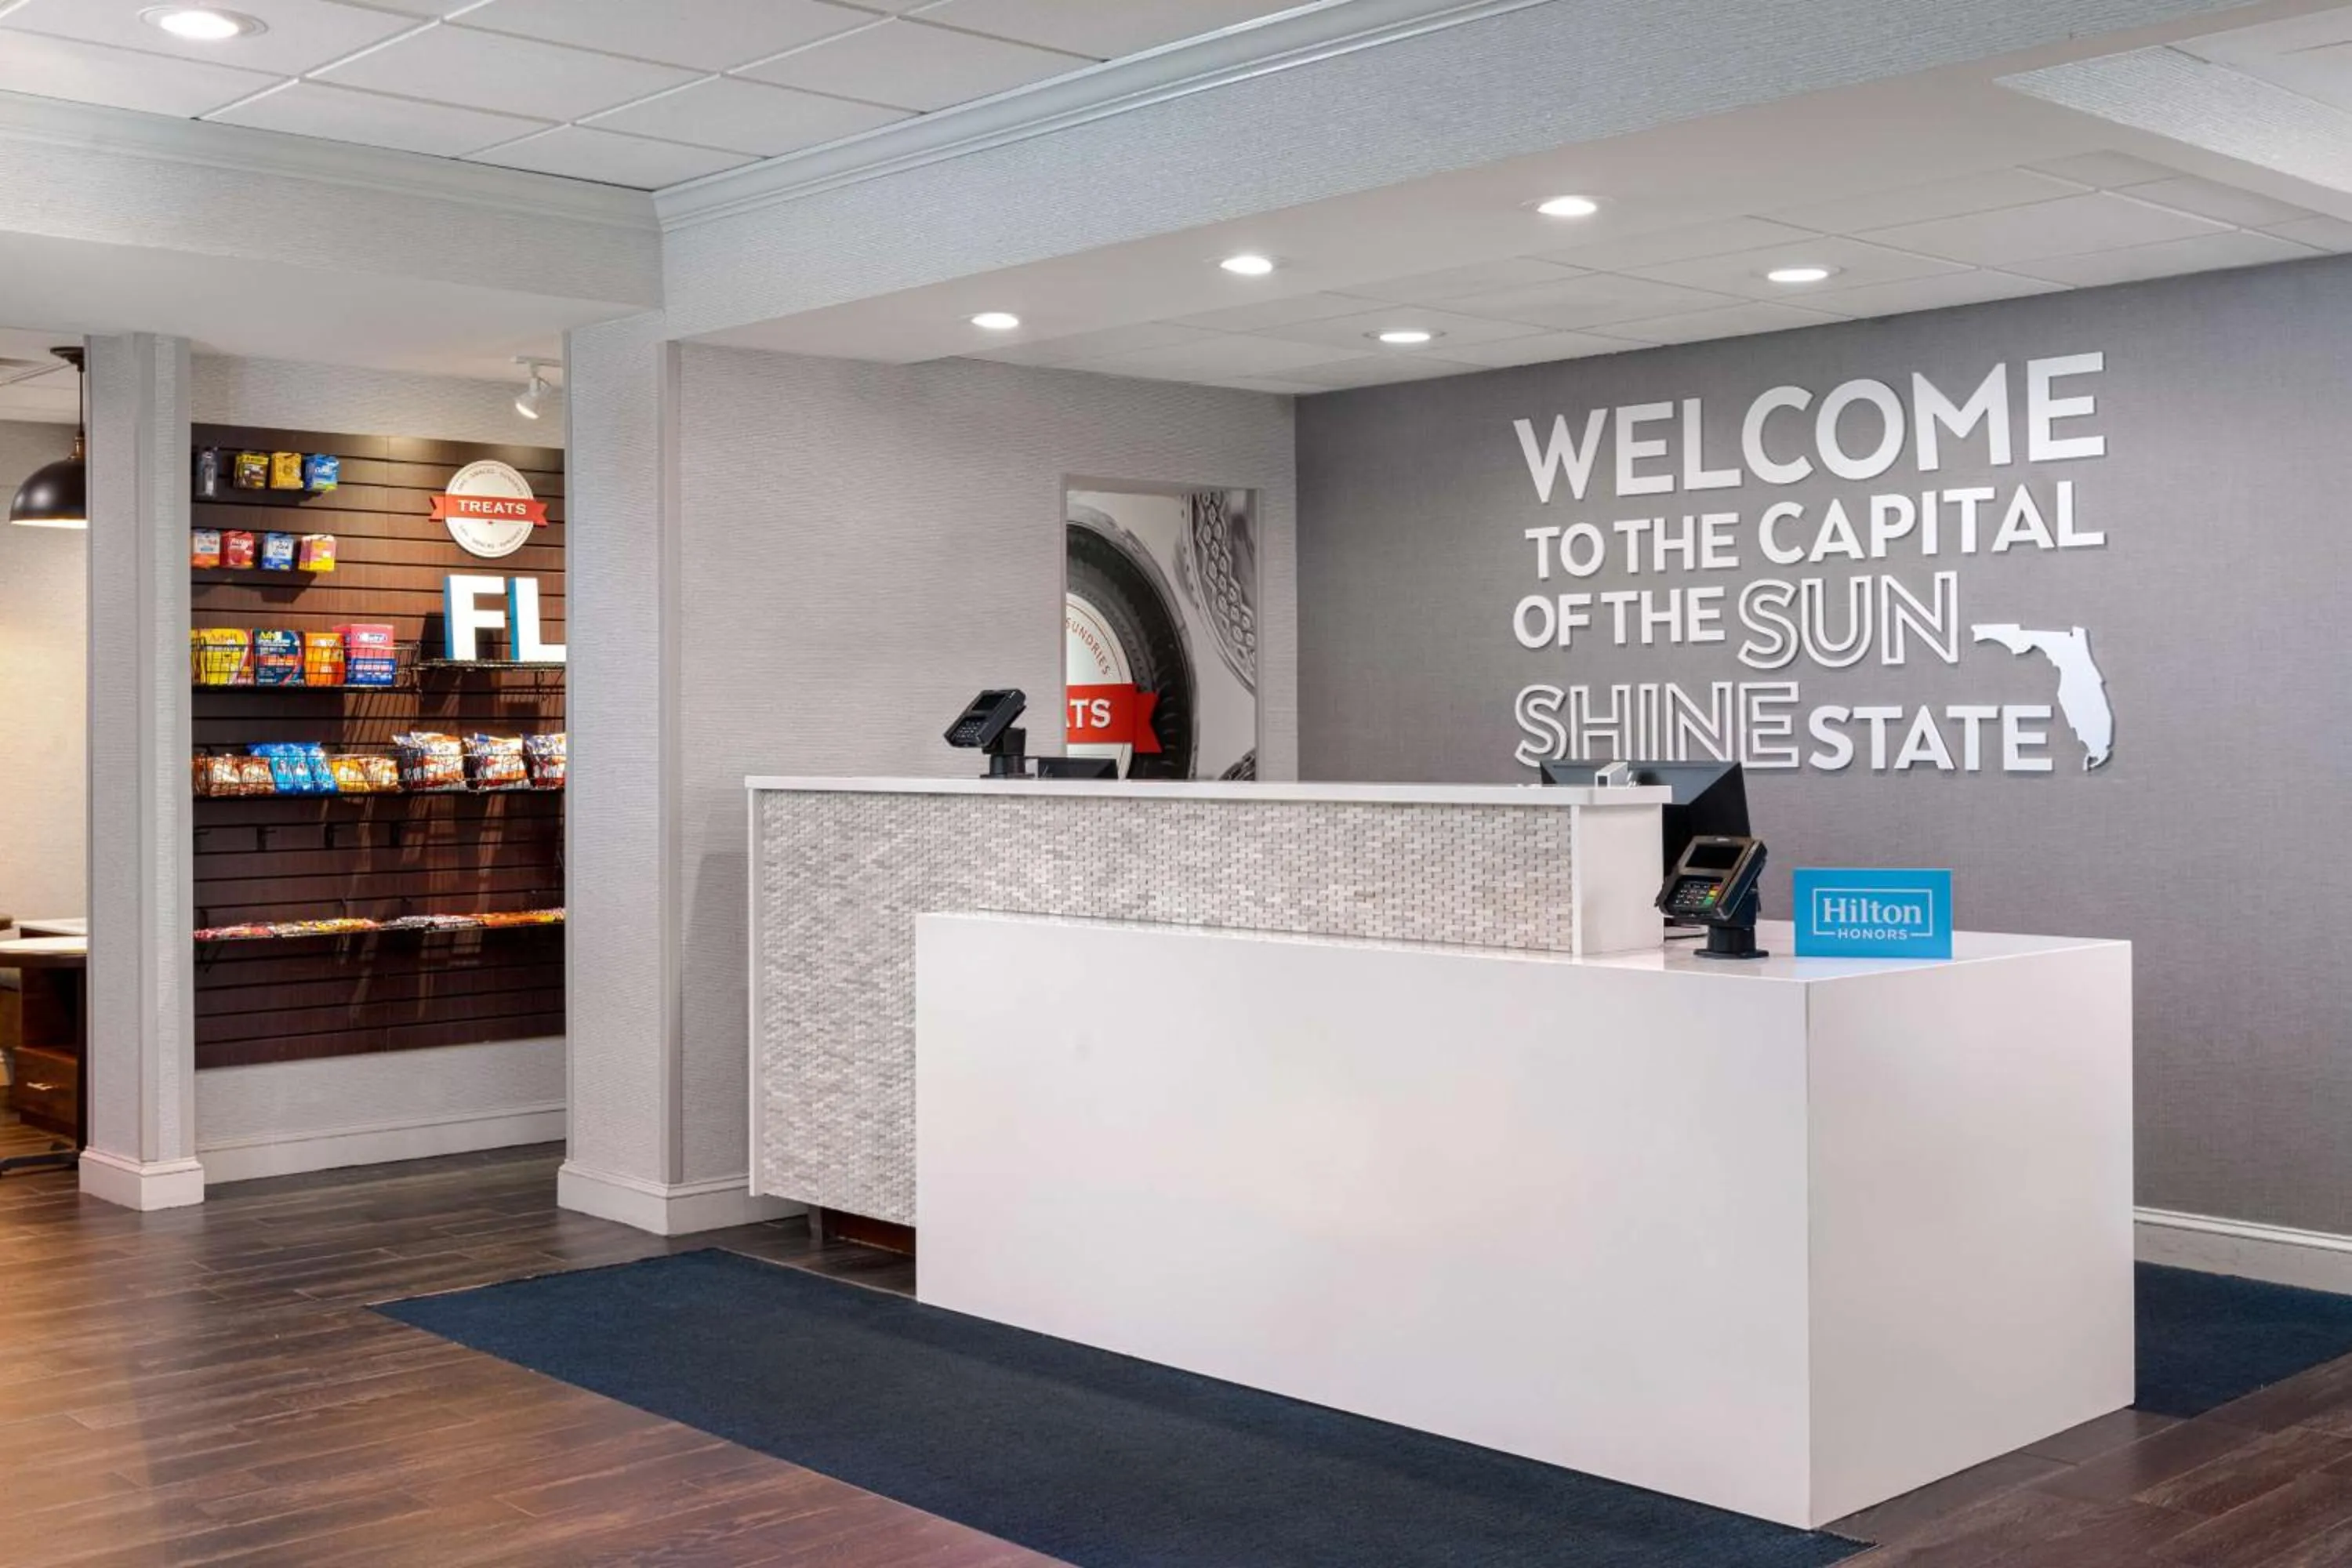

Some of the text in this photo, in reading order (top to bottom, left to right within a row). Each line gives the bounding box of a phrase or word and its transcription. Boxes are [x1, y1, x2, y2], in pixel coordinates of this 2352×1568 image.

[1513, 351, 2106, 503] WELCOME
[457, 499, 527, 515] TREATS
[1525, 481, 2106, 579] TO THE CAPITAL
[445, 574, 567, 662] FL
[1513, 571, 1958, 670] OF THE SUN
[1514, 681, 2054, 771] SHINE STATE
[1823, 897, 1923, 925] Hilton
[1837, 927, 1908, 941] HONORS
